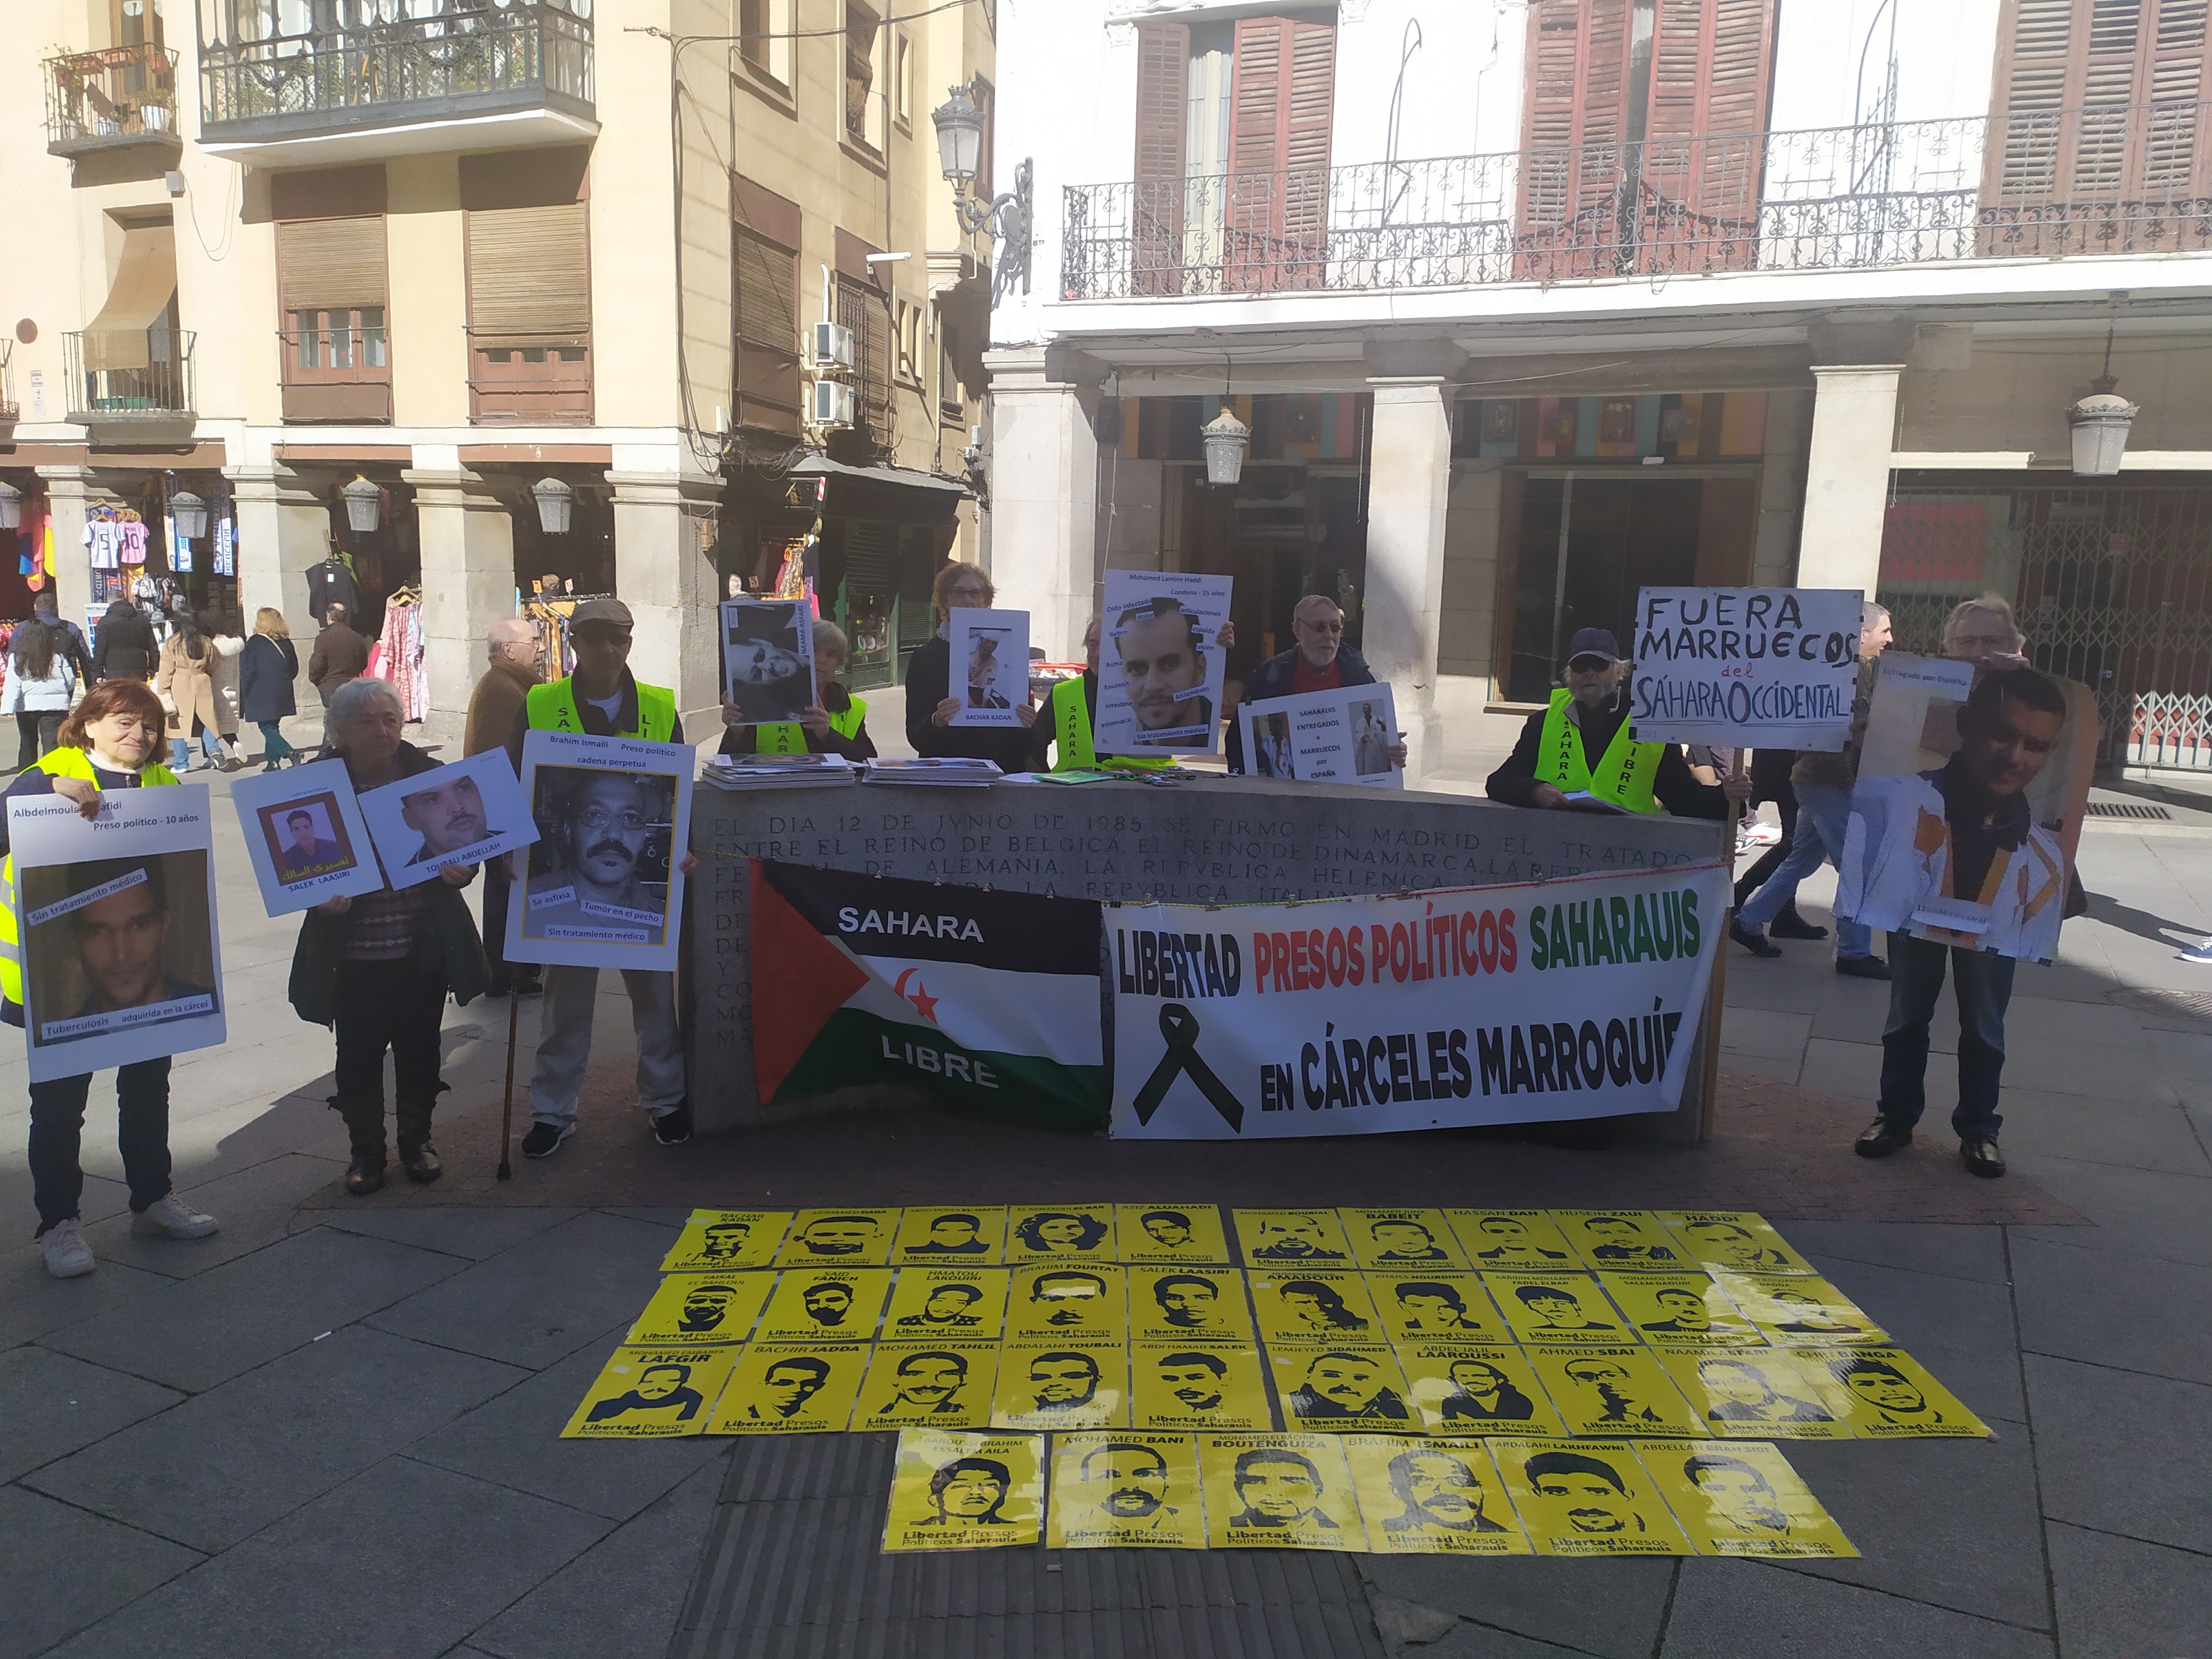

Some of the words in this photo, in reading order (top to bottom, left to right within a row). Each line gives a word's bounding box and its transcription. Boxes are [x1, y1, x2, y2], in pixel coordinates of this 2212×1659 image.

[100, 534, 109, 550] 5
[126, 533, 139, 550] 10
[1124, 598, 1152, 609] infectado
[1180, 607, 1221, 617] articulaciones
[1647, 593, 1802, 629] FUERA
[1109, 629, 1128, 638] fiebre
[1192, 626, 1215, 634] espalda
[1640, 628, 1856, 669] MARRUECOS
[1721, 661, 1754, 678] del
[1104, 681, 1130, 691] Enuresis
[1175, 686, 1210, 700] Aislamiento
[1300, 707, 1336, 717] SAHARAUIS
[1101, 718, 1132, 728] estomacal
[1297, 720, 1339, 731] ENTREGADOS
[1147, 727, 1183, 739] tratamiento
[1184, 725, 1206, 734] médico
[550, 735, 579, 747] Brahim
[581, 738, 608, 748] Ismaili
[621, 743, 644, 754] Preso
[645, 745, 676, 758] político
[1301, 745, 1341, 755] MARRUECOS
[577, 756, 607, 765] cadena
[609, 758, 646, 768] perpetua
[1311, 770, 1336, 779] ESPAÑA
[13, 805, 79, 818] Albdelmoula
[93, 820, 121, 831] Preso
[123, 817, 158, 829] político
[165, 815, 176, 825] 10
[178, 813, 199, 823] años
[715, 819, 745, 837] EL
[769, 817, 816, 834] DIA
[839, 817, 861, 832] 12
[883, 815, 916, 830] DE
[938, 815, 1013, 831] JVNIO
[1034, 815, 1065, 830] DE
[1087, 816, 1141, 832] 1985
[1167, 818, 1190, 833] SE
[1212, 819, 1295, 838] FIRMO
[1318, 823, 1351, 840] EN
[1373, 828, 1480, 851] MADRID
[1504, 837, 1534, 855] EL
[1562, 842, 1692, 868] TRATADO
[715, 841, 802, 860] ENTRE
[818, 839, 849, 855] EL
[865, 837, 946, 854] REINO
[962, 837, 992, 852] DE
[1183, 840, 1262, 859] REINO
[1273, 843, 1302, 860] DE
[426, 856, 460, 873] TOUBALI
[461, 842, 501, 863] ABDELLAH
[1086, 860, 1114, 874] LA
[1143, 859, 1285, 880] REPVBLICA
[289, 880, 315, 893] SALEK
[318, 870, 351, 884] LAASIRI
[32, 910, 49, 922] Sin
[50, 887, 108, 915] tratamiento
[109, 873, 143, 895] médico
[532, 898, 543, 906] Se
[545, 891, 571, 904] asfixia
[585, 902, 611, 914] Tumor
[625, 908, 633, 917] el
[634, 911, 659, 924] pecho
[838, 907, 984, 942] SAHARA
[548, 928, 561, 937] Sin
[563, 930, 613, 939] tratamiento
[615, 931, 645, 941] médico
[1118, 929, 1240, 998] LIBERTAD
[1254, 925, 1365, 994] PRESOS
[1371, 900, 1517, 984] POLÍTICOS
[1530, 888, 1700, 971] SAHARAUIS
[46, 1016, 109, 1036] Tuberculosis
[122, 1009, 161, 1024] adquirida
[184, 1000, 208, 1012] cárcel
[880, 1034, 999, 1092] LIBRE
[1261, 1064, 1293, 1109] EN
[1301, 1021, 1473, 1106] CÁRCELES
[1020, 1264, 1064, 1274] BRAHIM
[1066, 1264, 1119, 1272] FOURTAT
[637, 1355, 712, 1364] LAFGIR
[1417, 1351, 1505, 1360] LAAROUSSI
[1348, 1438, 1409, 1447] BRAHIM
[1495, 1441, 1550, 1449] ABDALAHI
[903, 1530, 967, 1539] Libertad
[969, 1529, 1018, 1537] Presos
[1227, 1531, 1292, 1540] Libertad
[1295, 1532, 1344, 1541] Presos
[902, 1537, 954, 1546] Políticos
[956, 1536, 1017, 1545] Saharauis
[1283, 1539, 1345, 1547] Saharauis
